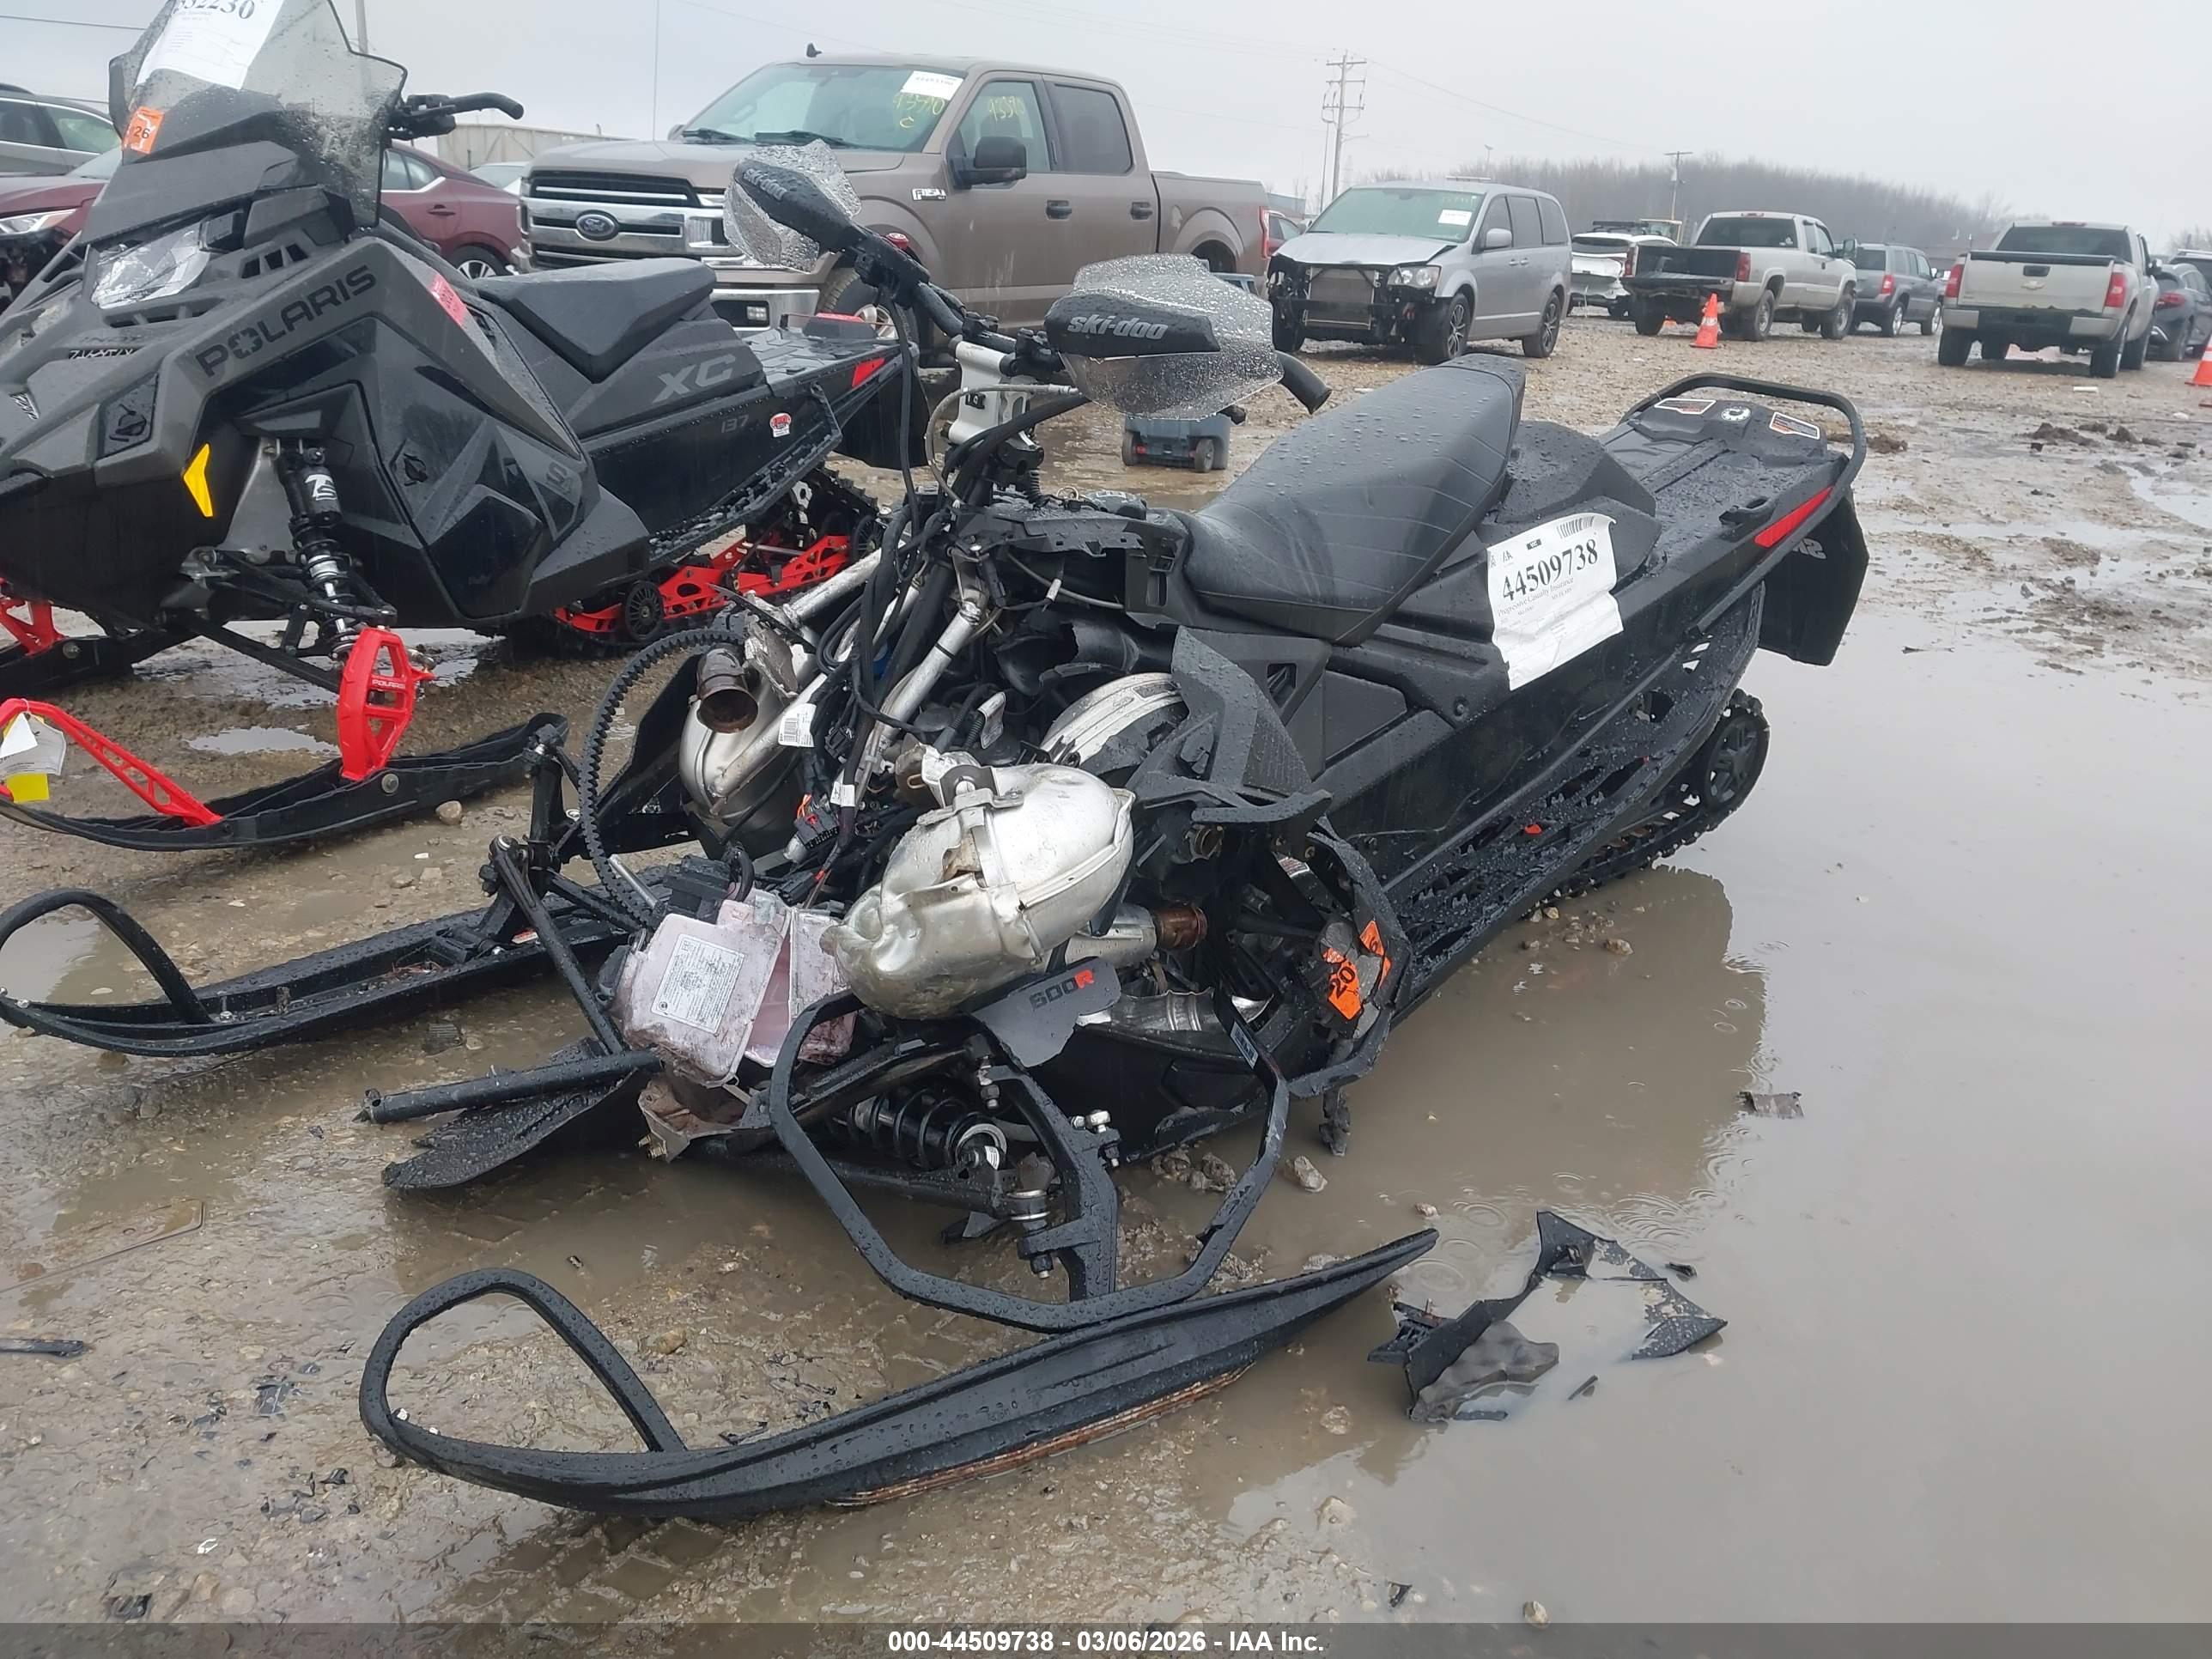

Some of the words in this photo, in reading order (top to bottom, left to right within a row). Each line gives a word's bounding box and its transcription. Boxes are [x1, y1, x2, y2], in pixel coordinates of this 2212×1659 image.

[134, 126, 150, 139] 26
[195, 264, 377, 378] POLARIS
[1067, 314, 1169, 340] ski-doo
[652, 354, 736, 404] XC
[721, 415, 750, 434] 137
[1502, 538, 1598, 601] 44509738
[1328, 966, 1356, 999] 20
